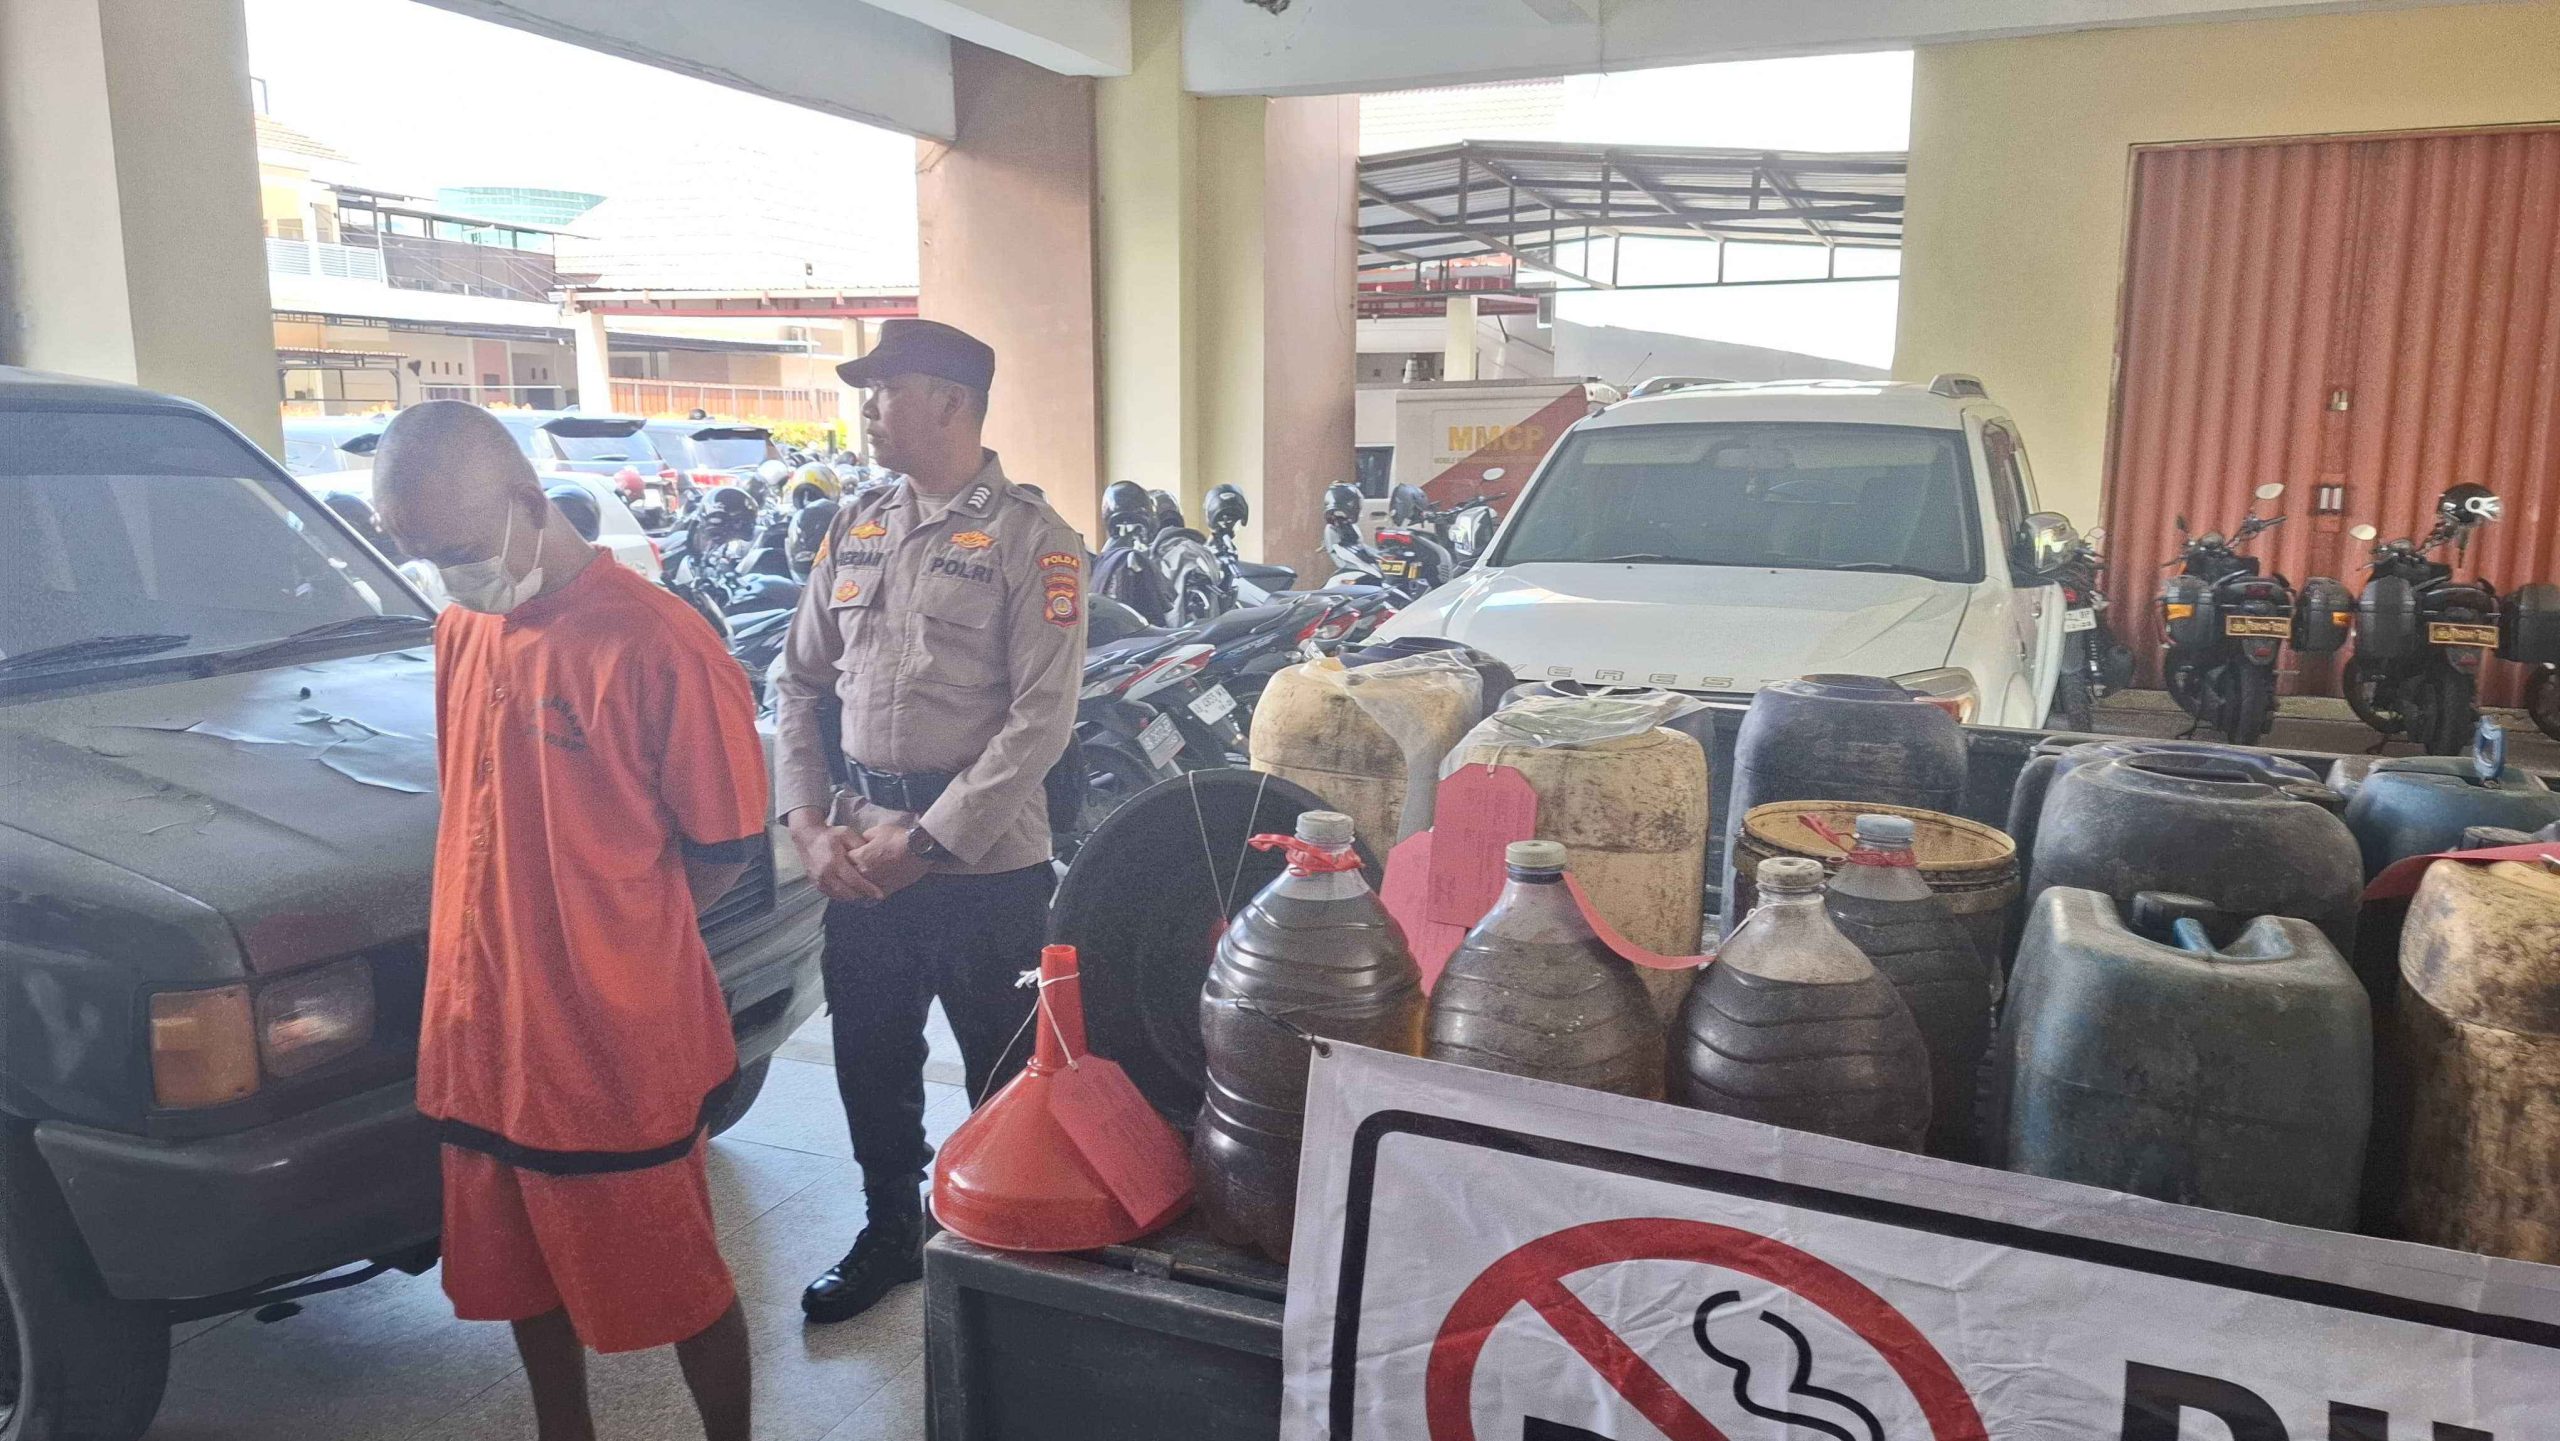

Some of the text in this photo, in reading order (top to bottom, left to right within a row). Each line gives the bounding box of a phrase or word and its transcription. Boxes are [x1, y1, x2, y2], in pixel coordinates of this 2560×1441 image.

[1448, 425, 1545, 452] MMCP
[929, 557, 994, 583] POLRI
[1042, 555, 1079, 569] POLDA
